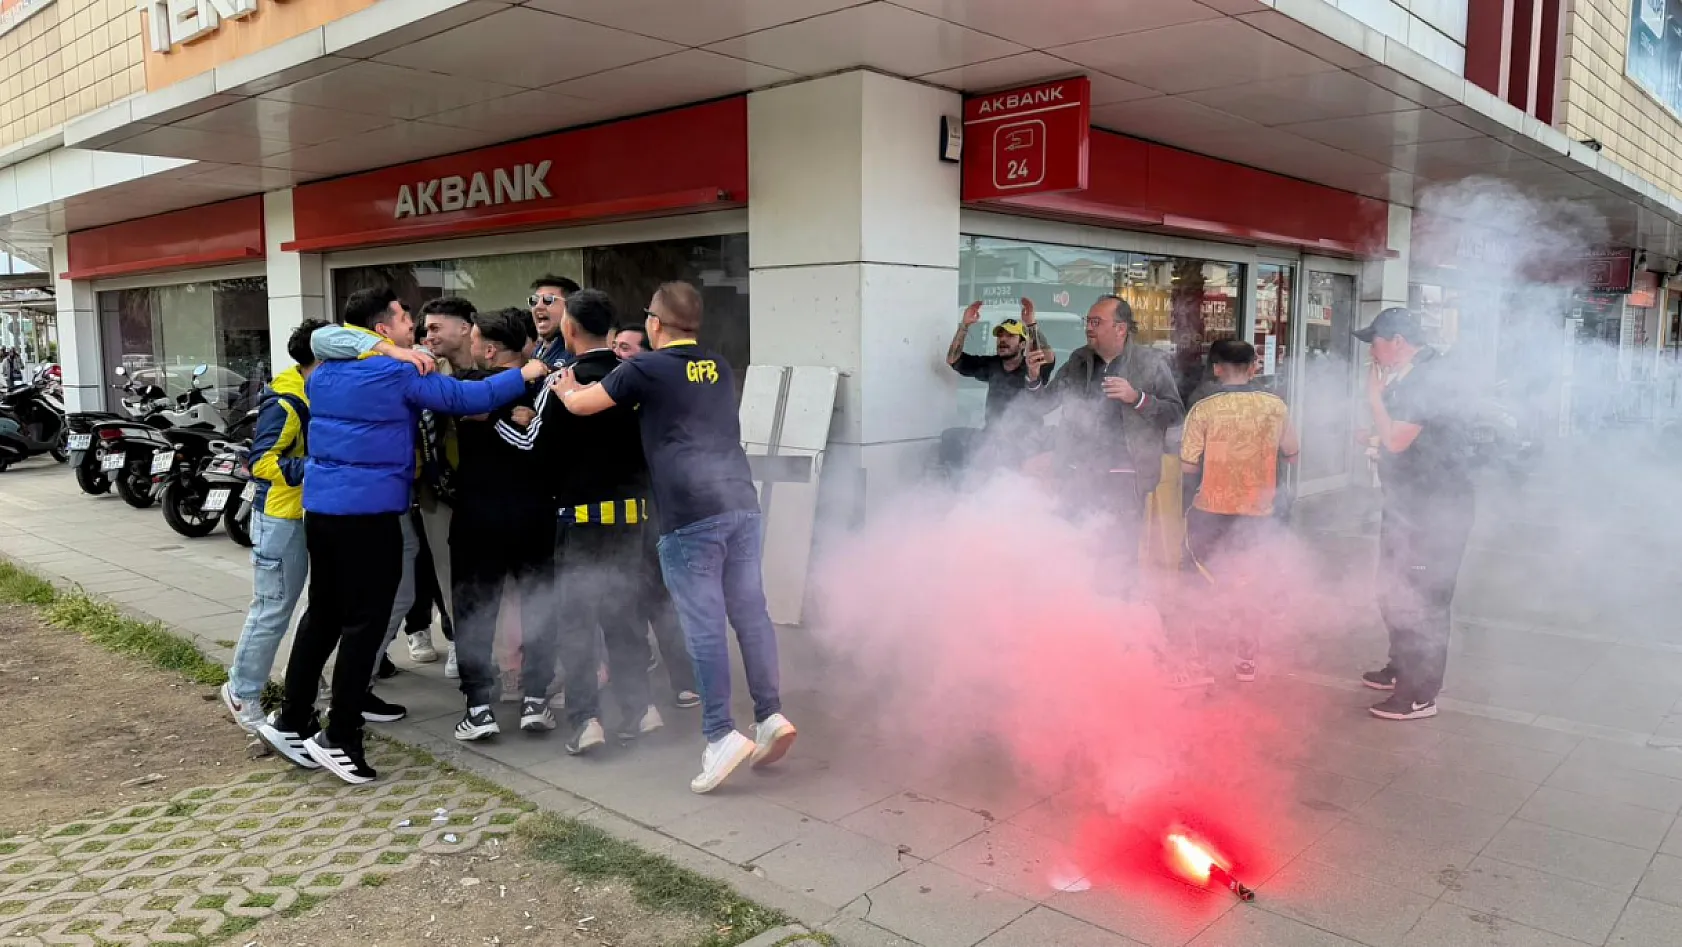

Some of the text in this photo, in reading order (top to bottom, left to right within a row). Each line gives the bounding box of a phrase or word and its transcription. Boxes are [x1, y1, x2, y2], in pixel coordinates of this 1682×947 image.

[979, 86, 1064, 114] AKBANK
[1007, 159, 1029, 179] 24
[394, 159, 553, 219] AKBANK
[687, 359, 718, 384] GFB
